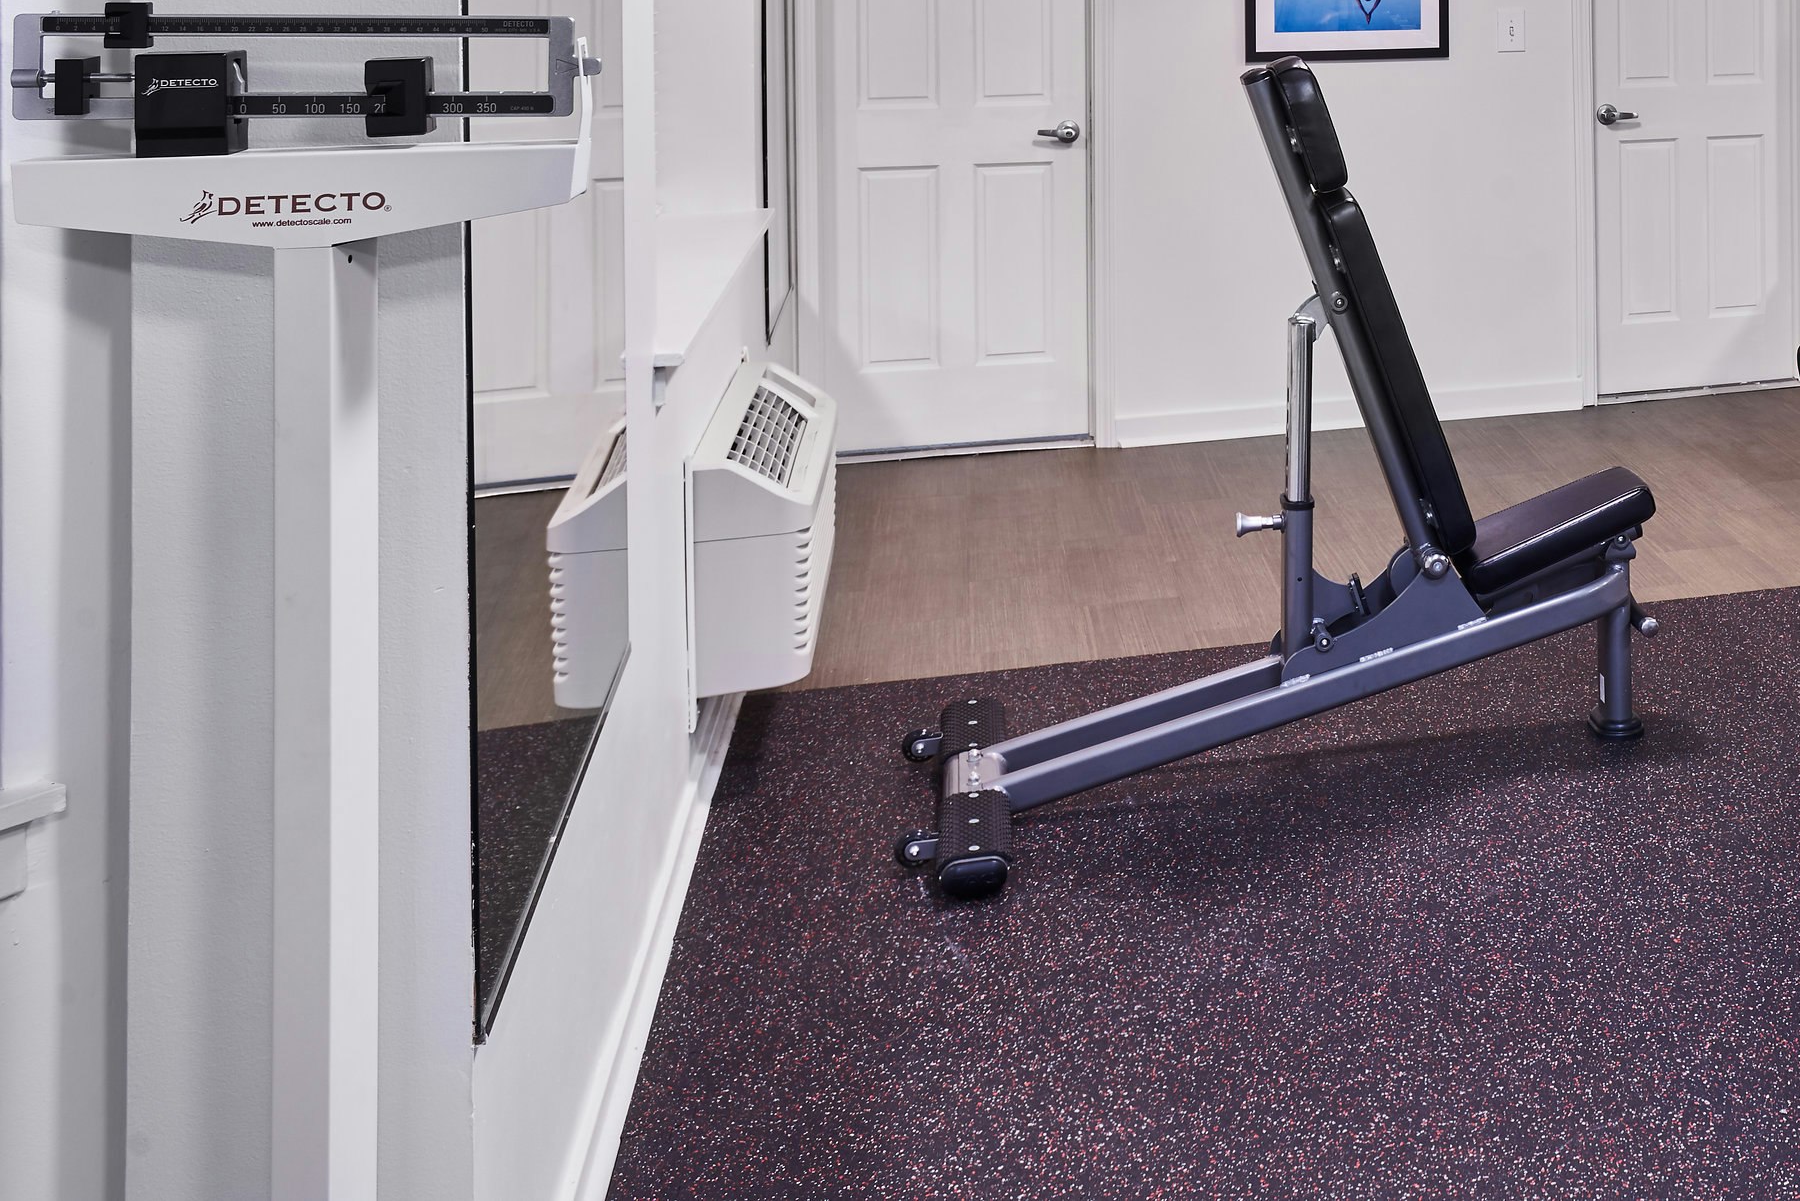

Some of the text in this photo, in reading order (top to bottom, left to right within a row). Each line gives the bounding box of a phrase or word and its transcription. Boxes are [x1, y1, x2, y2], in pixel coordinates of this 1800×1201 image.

[502, 20, 534, 28] DETECTO
[160, 78, 217, 87] DETECTO
[240, 104, 247, 114] 0
[272, 104, 286, 114] 50
[305, 103, 325, 114] 100
[340, 103, 360, 114] 150
[442, 103, 463, 113] 300
[476, 103, 497, 113] 350
[218, 192, 386, 216] DETECTO
[252, 217, 352, 228] www.detectoscale.com
